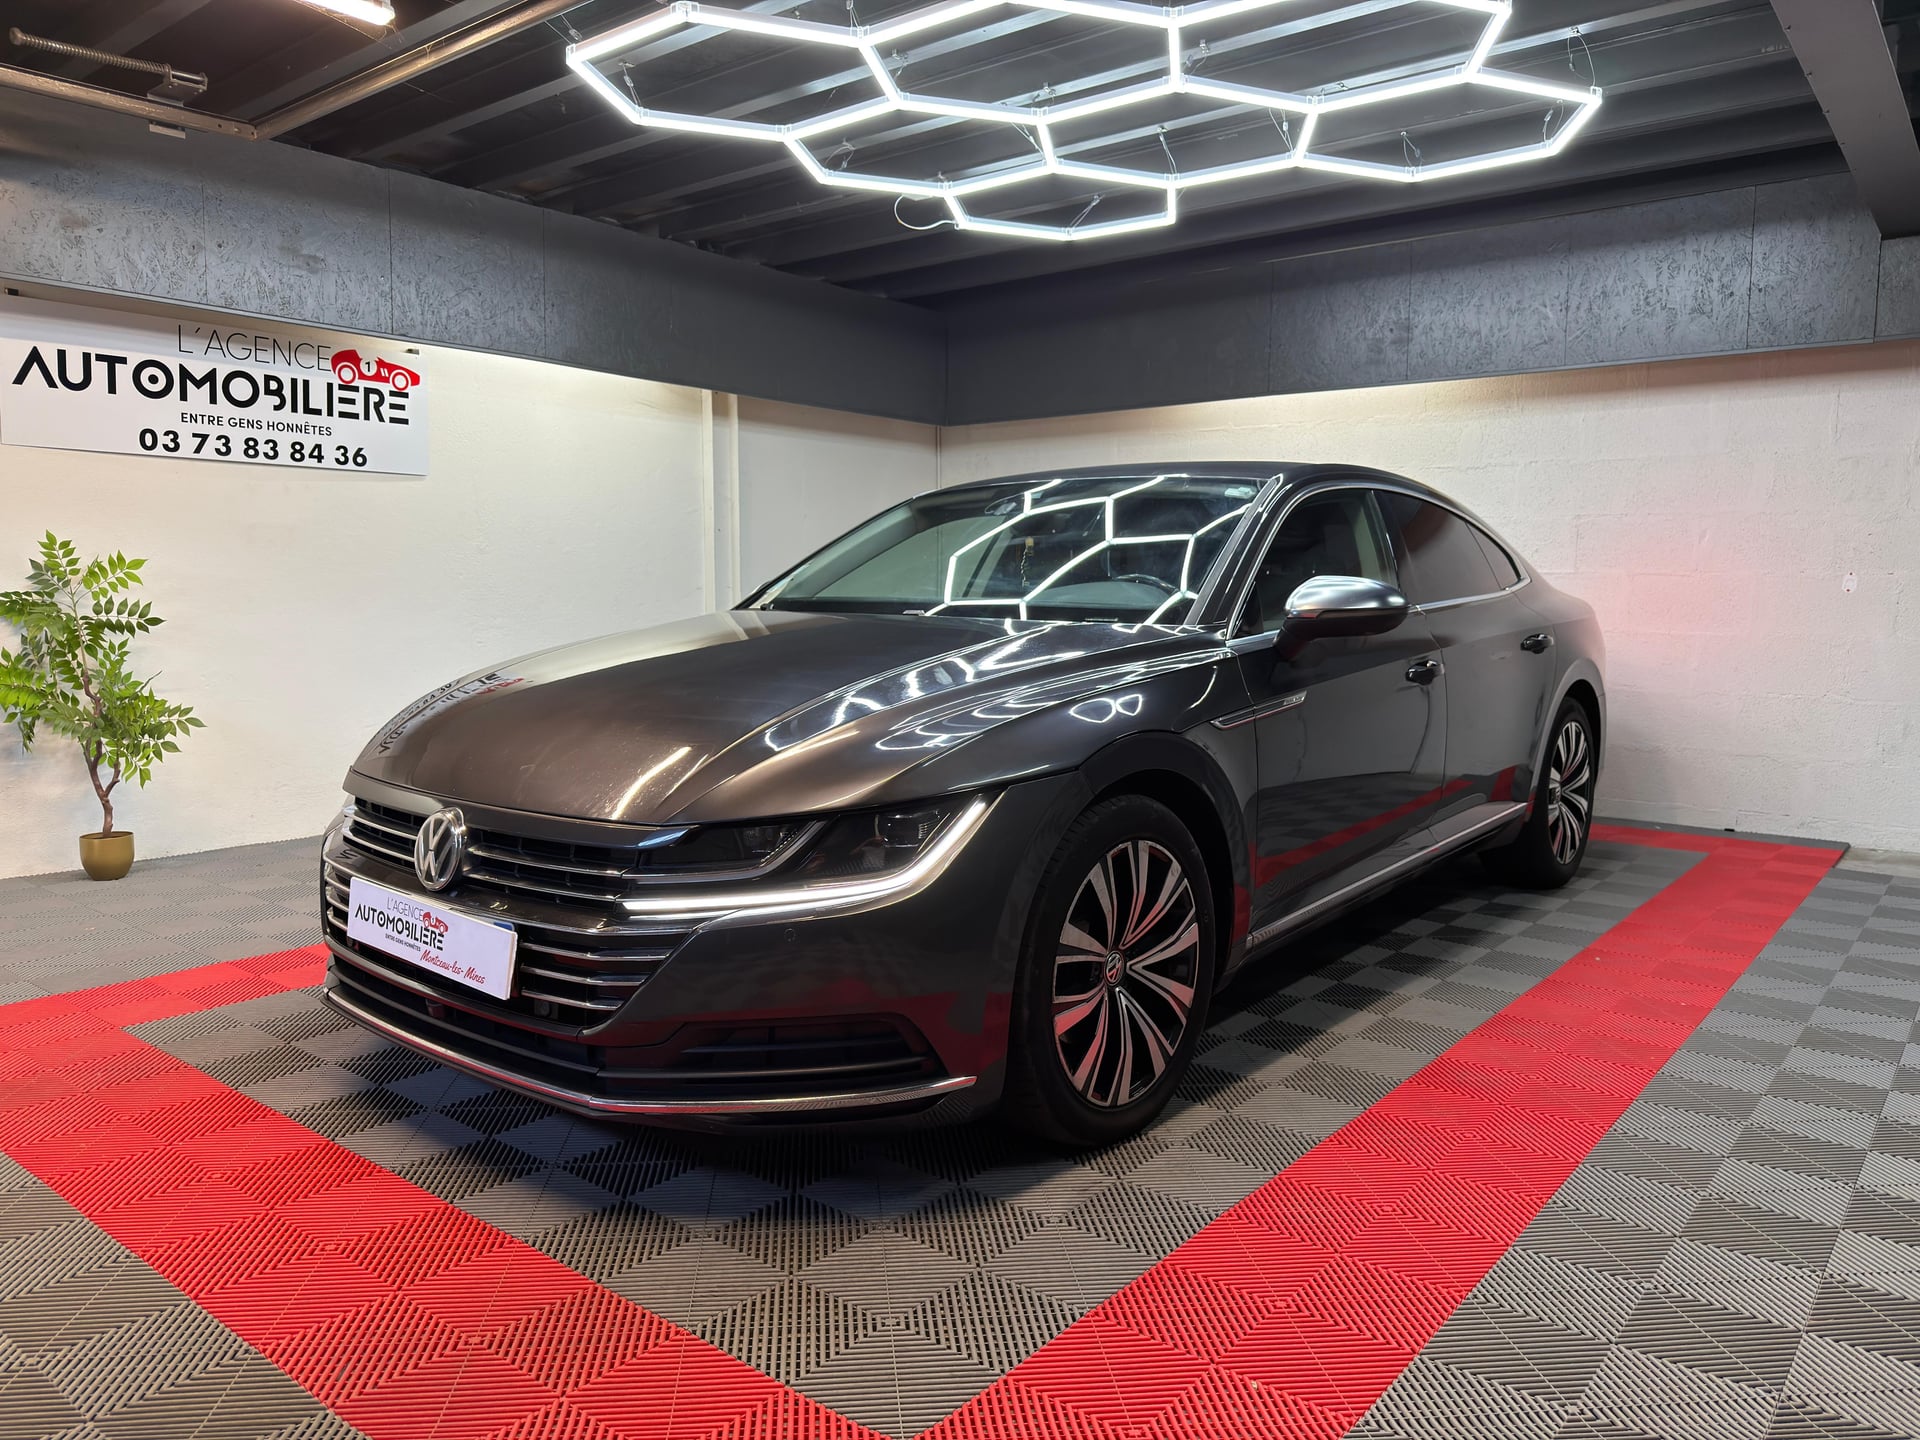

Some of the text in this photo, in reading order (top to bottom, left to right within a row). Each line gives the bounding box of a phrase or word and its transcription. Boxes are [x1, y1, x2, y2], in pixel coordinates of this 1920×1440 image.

[178, 324, 331, 371] L'AGENCE
[364, 361, 371, 373] 1
[181, 412, 332, 437] ENTRE GENS HONNÊTES
[139, 428, 368, 467] 03 73 83 84 36
[386, 897, 424, 922] L'AGENCE
